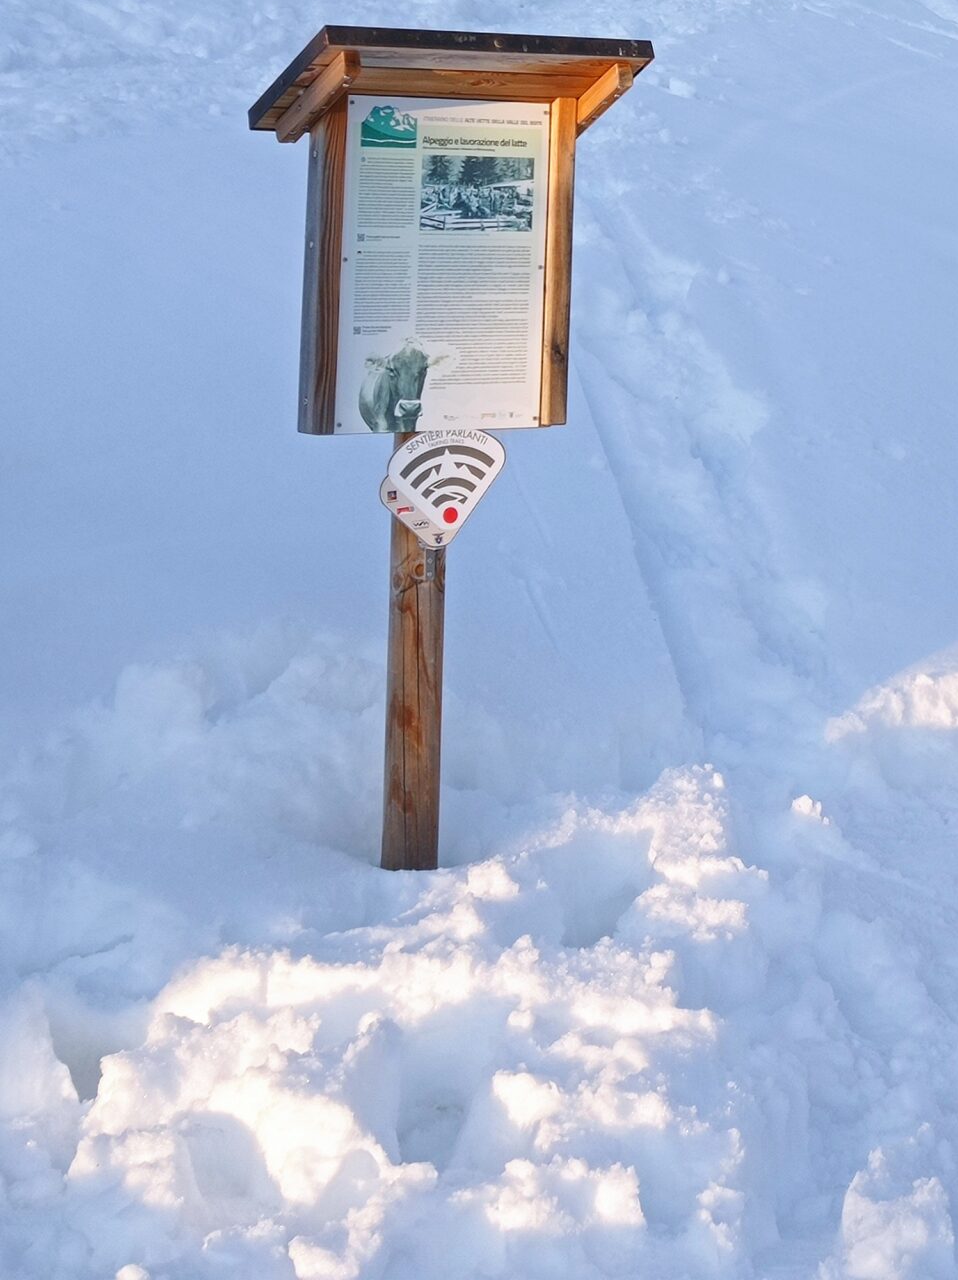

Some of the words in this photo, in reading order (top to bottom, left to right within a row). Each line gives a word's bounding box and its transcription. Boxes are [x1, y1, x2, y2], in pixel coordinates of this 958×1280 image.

[422, 136, 453, 147] Alpeggio
[460, 137, 499, 146] lavorazione
[500, 138, 510, 146] del
[511, 138, 528, 147] latte
[406, 431, 444, 454] SENTIERI
[445, 429, 488, 446] PARLANTI
